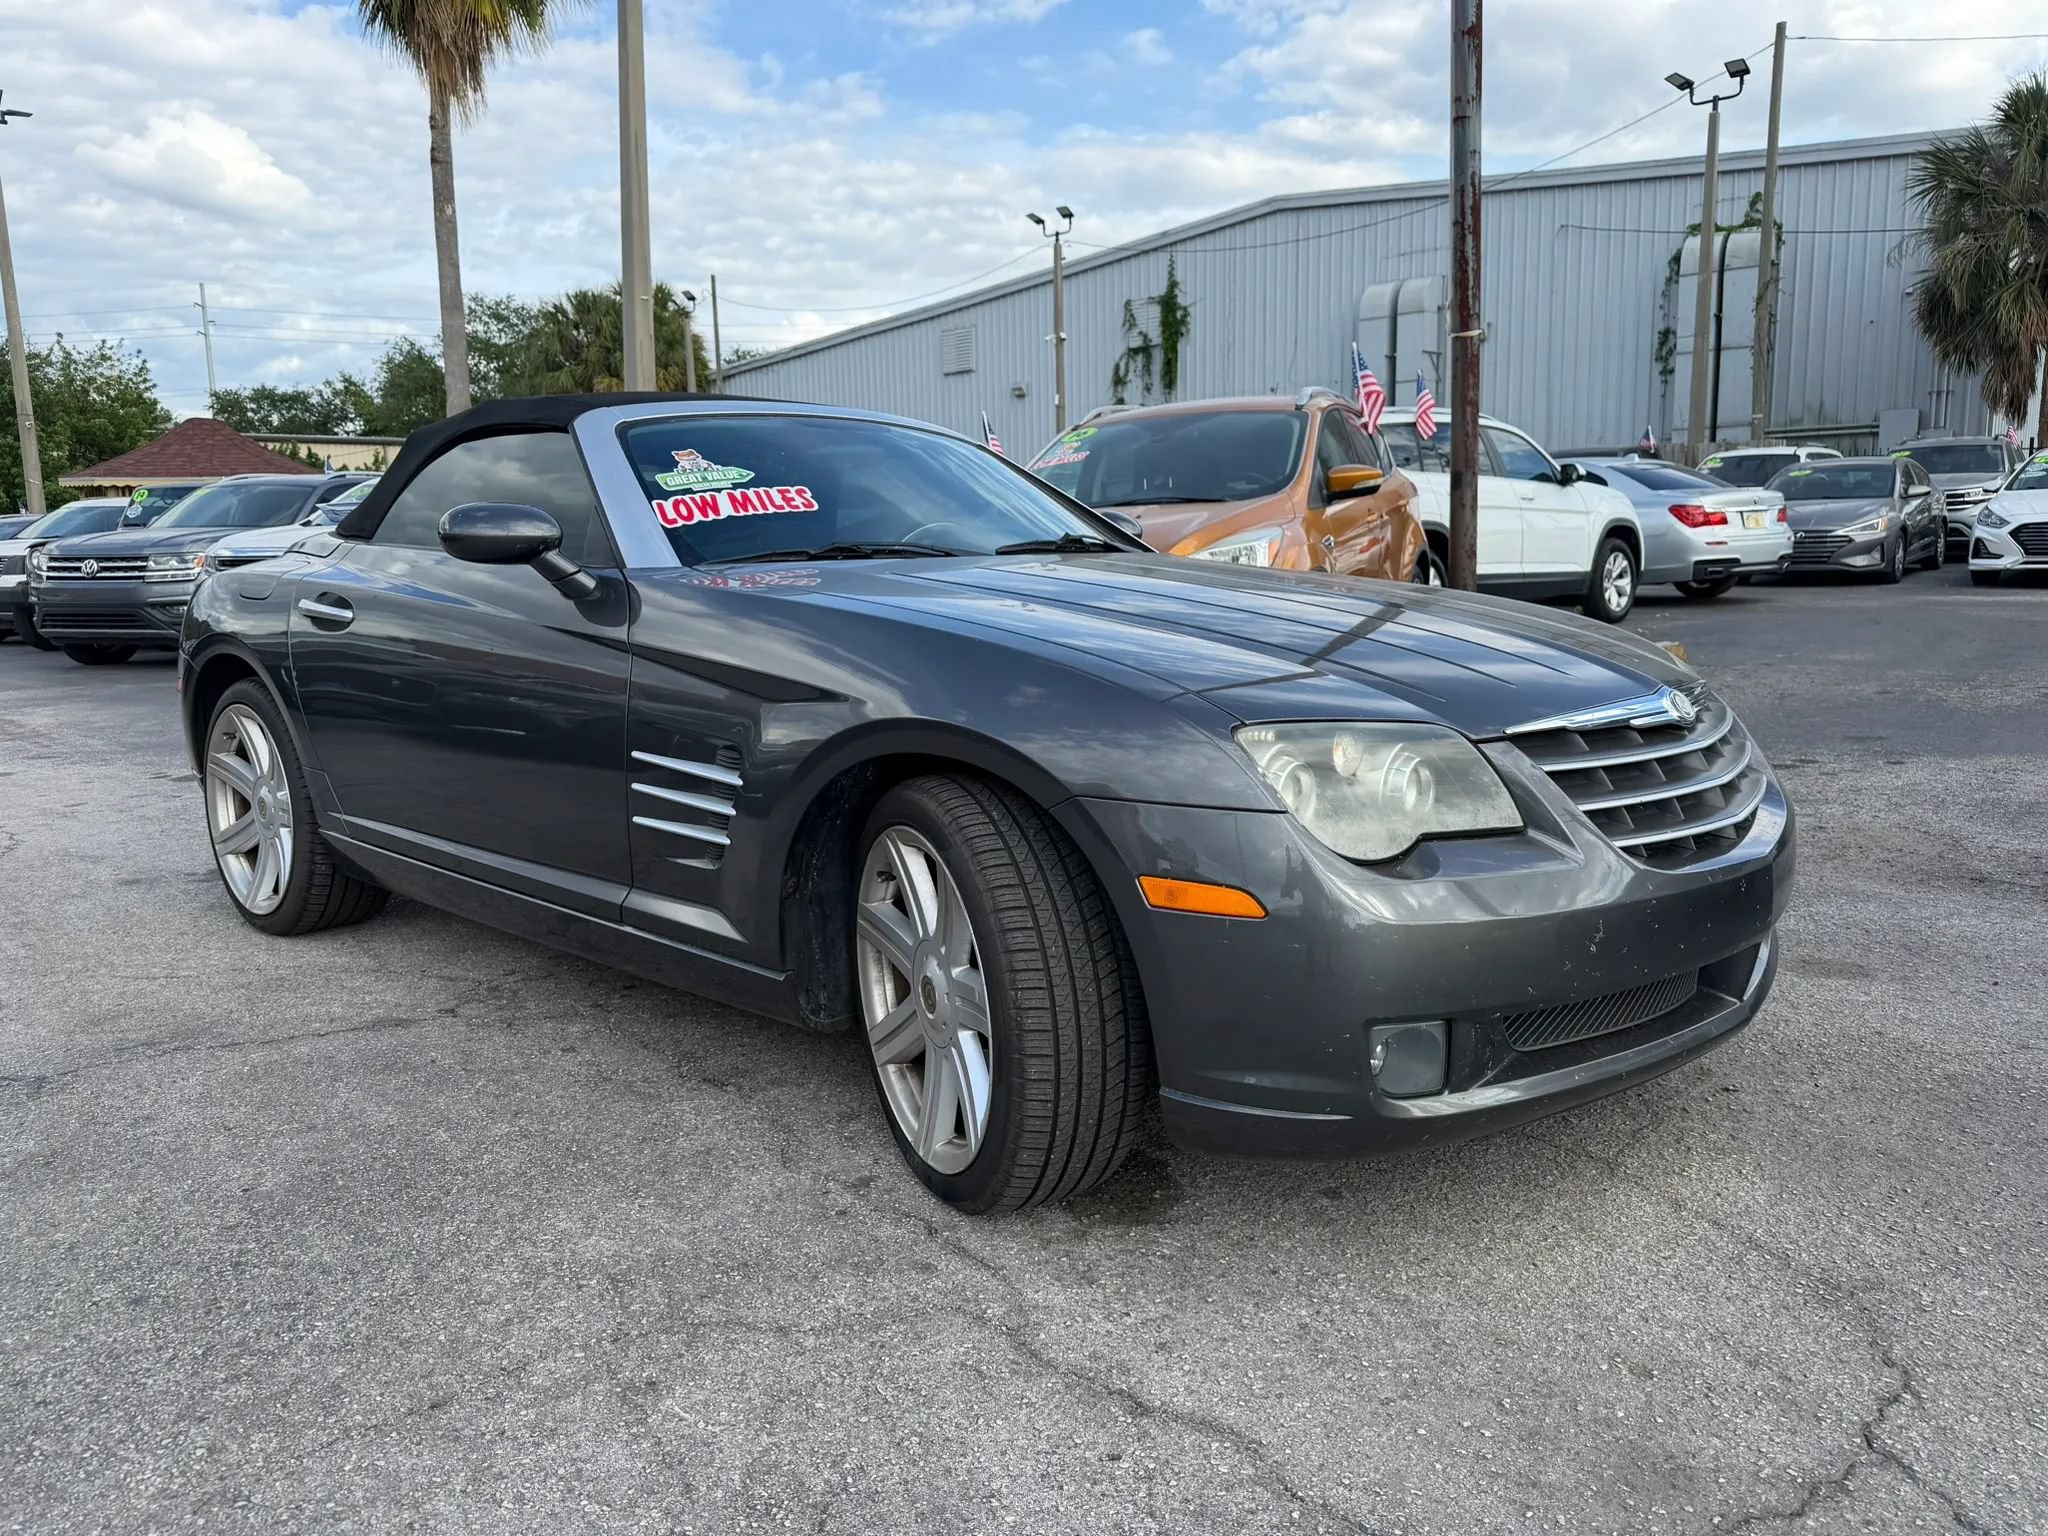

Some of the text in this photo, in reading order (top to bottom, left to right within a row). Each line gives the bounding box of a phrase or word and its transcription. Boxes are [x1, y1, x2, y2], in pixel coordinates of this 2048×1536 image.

[666, 472, 704, 486] GREAT
[705, 470, 741, 481] VALUE
[655, 486, 816, 526] LOW MILES
